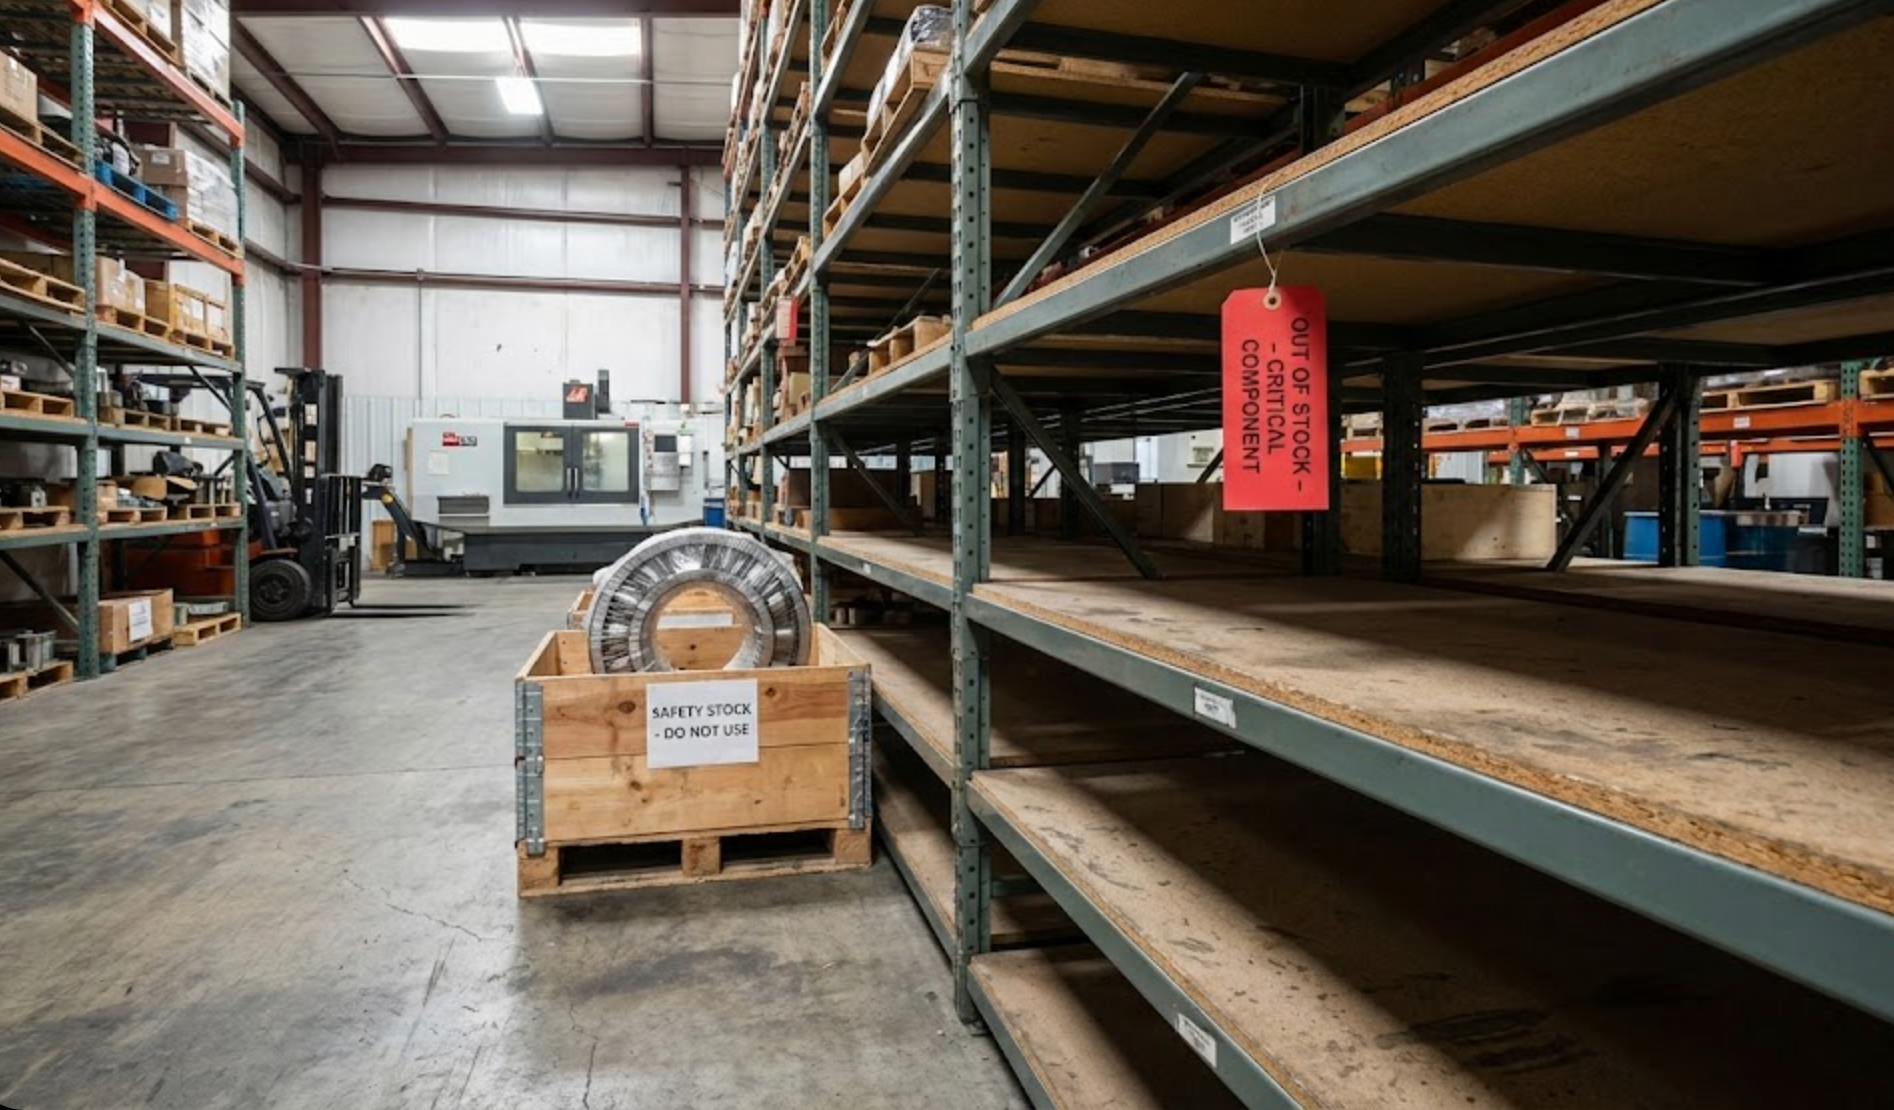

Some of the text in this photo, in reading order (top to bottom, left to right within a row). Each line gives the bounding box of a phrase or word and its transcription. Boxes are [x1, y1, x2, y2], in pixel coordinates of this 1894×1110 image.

[1291, 317, 1310, 360] OUT
[1292, 367, 1310, 395] OF
[1241, 339, 1260, 474] COMPONENT
[1266, 359, 1286, 455] CRITICAL
[1292, 403, 1311, 474] STOCK
[652, 702, 752, 719] SAFETY STOCK
[664, 726, 686, 739] DO
[690, 725, 719, 738] NOT
[723, 723, 750, 737] USE
